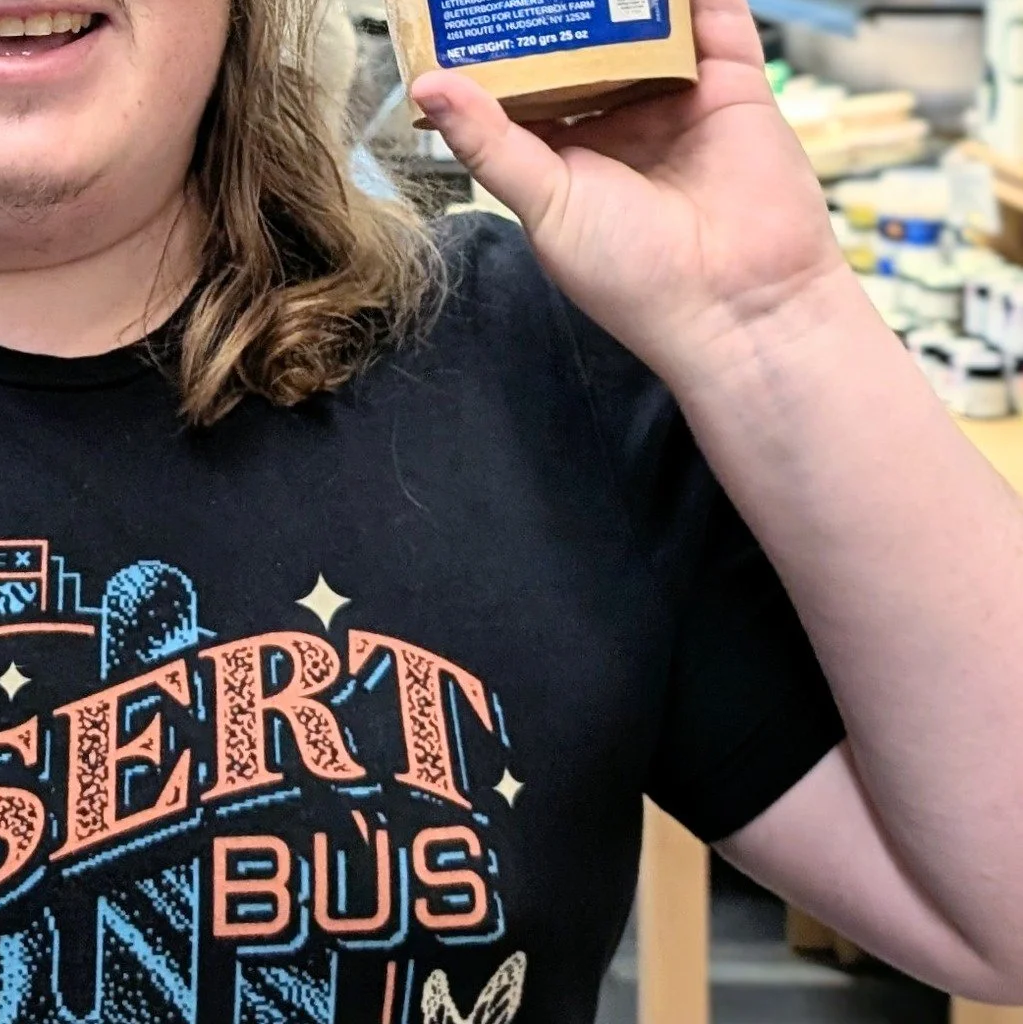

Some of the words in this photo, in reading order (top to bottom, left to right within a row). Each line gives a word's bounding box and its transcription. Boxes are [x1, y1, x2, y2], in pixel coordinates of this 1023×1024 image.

[444, 15, 491, 30] PRODUCED
[492, 12, 510, 22] FOR
[512, 2, 567, 19] LETTERBOX
[568, 0, 596, 10] FARM
[464, 25, 494, 37] ROUTE
[506, 17, 548, 30] HUDSON,
[550, 16, 563, 24] NY
[565, 12, 591, 22] 12534
[446, 46, 466, 59] NET
[468, 39, 514, 55] WEIGHT:
[516, 36, 536, 48] 720
[538, 34, 557, 46] grs
[559, 30, 574, 41] 25
[574, 30, 588, 39] oz
[213, 824, 488, 937] BUS
